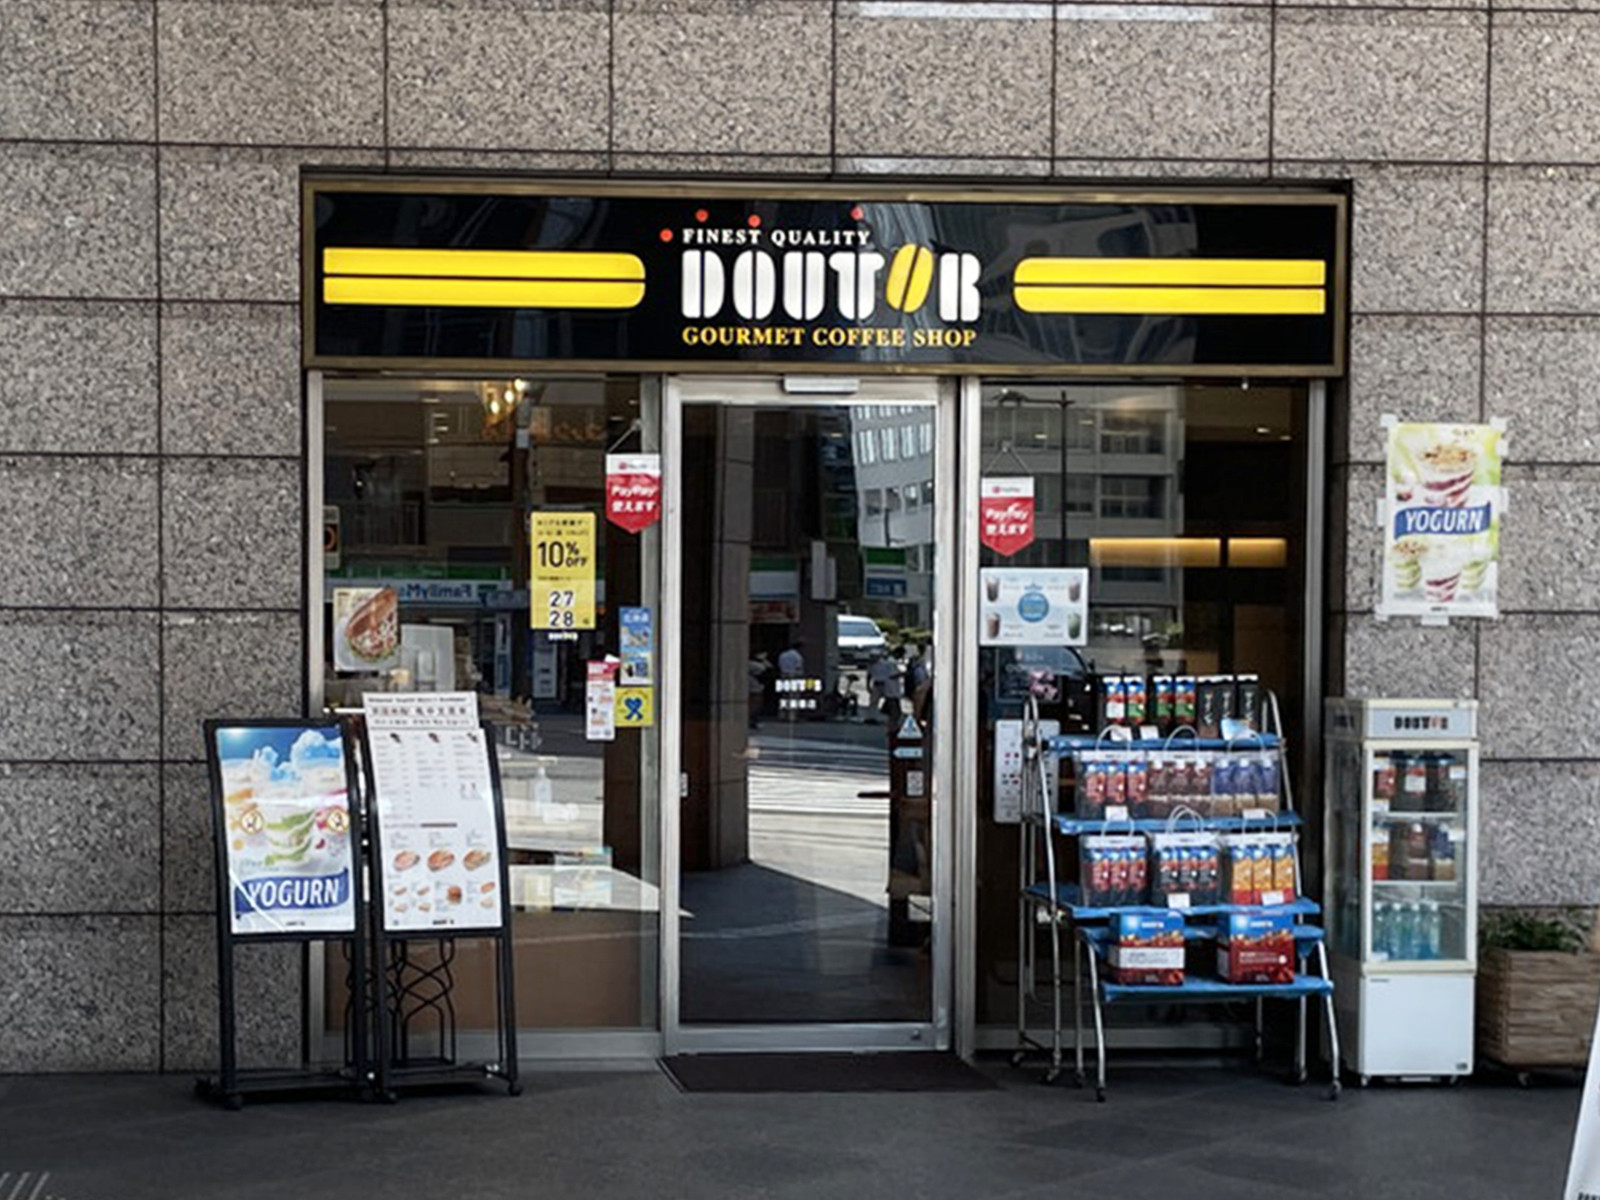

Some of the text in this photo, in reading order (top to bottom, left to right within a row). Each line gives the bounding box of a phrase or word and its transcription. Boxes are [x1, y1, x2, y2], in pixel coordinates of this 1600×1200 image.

[682, 229, 871, 247] FINEST QUALITY
[682, 243, 981, 322] DOUTOR
[682, 327, 977, 348] GOURMET COFFEE SHOP
[611, 485, 659, 498] PayPay
[1404, 509, 1484, 532] YOGURN
[549, 590, 574, 607] 27
[549, 610, 574, 627] 28
[247, 878, 340, 907] YOGURN
